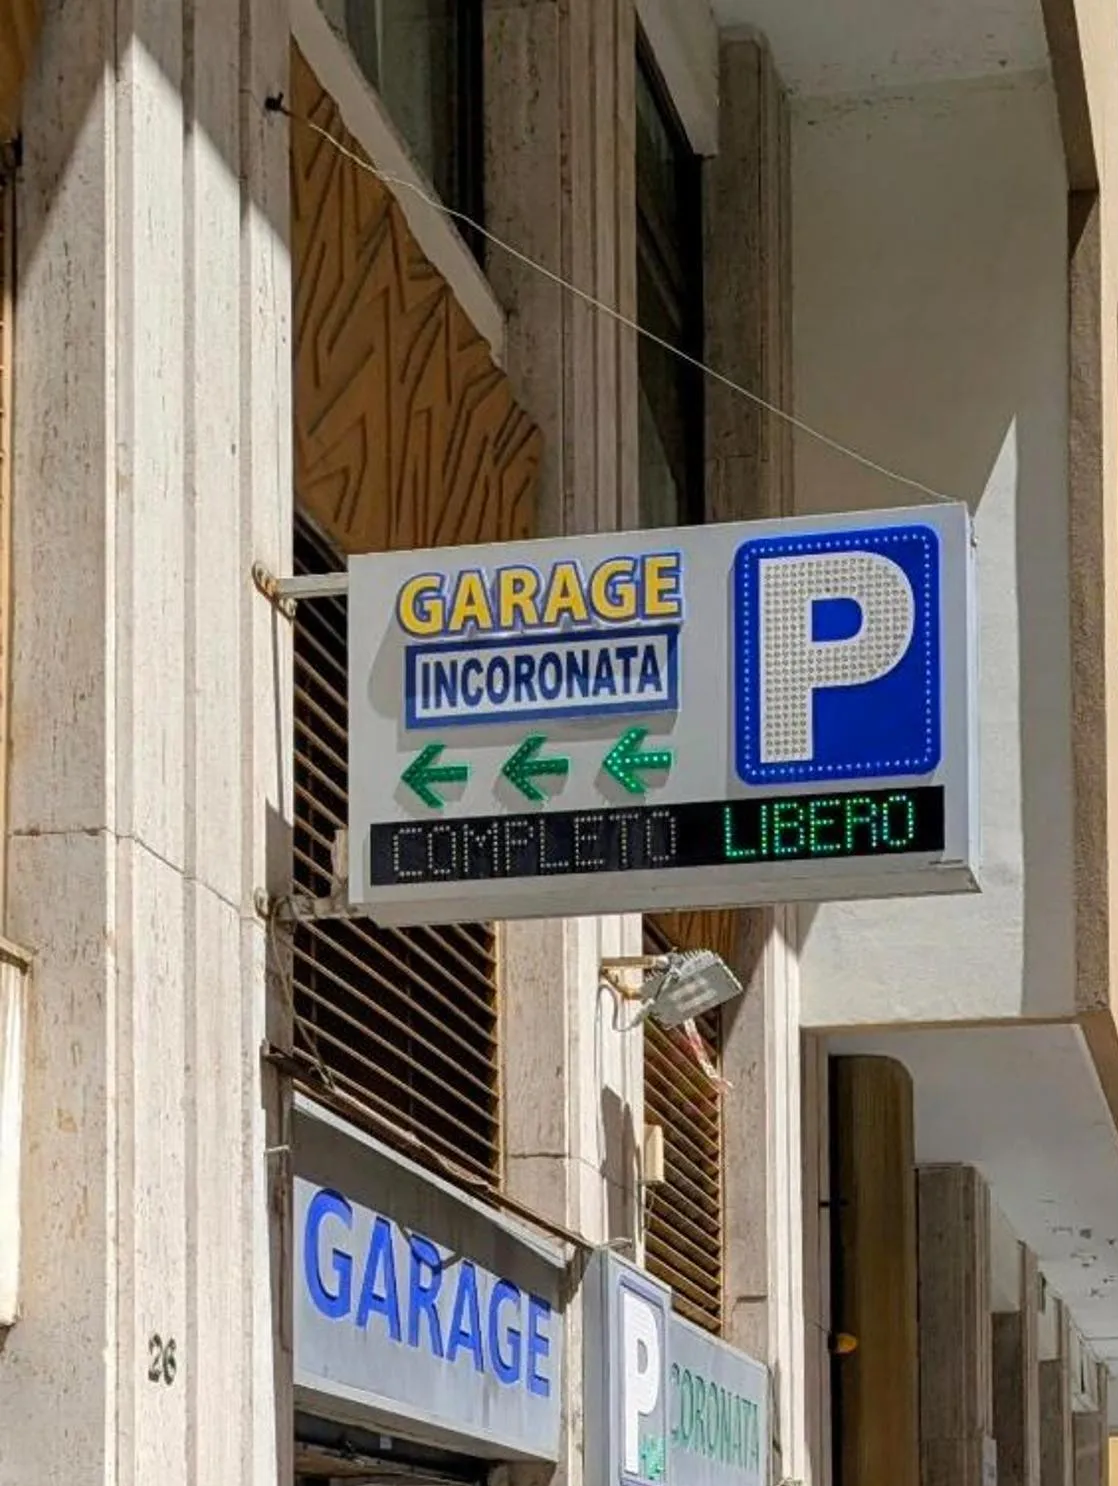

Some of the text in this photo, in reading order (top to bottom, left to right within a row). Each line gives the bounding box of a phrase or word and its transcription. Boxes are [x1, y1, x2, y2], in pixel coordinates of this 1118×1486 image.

[399, 553, 681, 637] GARAGE
[421, 645, 662, 709] INCORONATA
[760, 550, 914, 763] P
[393, 795, 914, 878] COMPLETO LIBERO
[304, 1188, 551, 1398] GARAGE
[147, 1332, 177, 1386] 26
[623, 1292, 661, 1475] P
[670, 1362, 761, 1472] CORONATA
